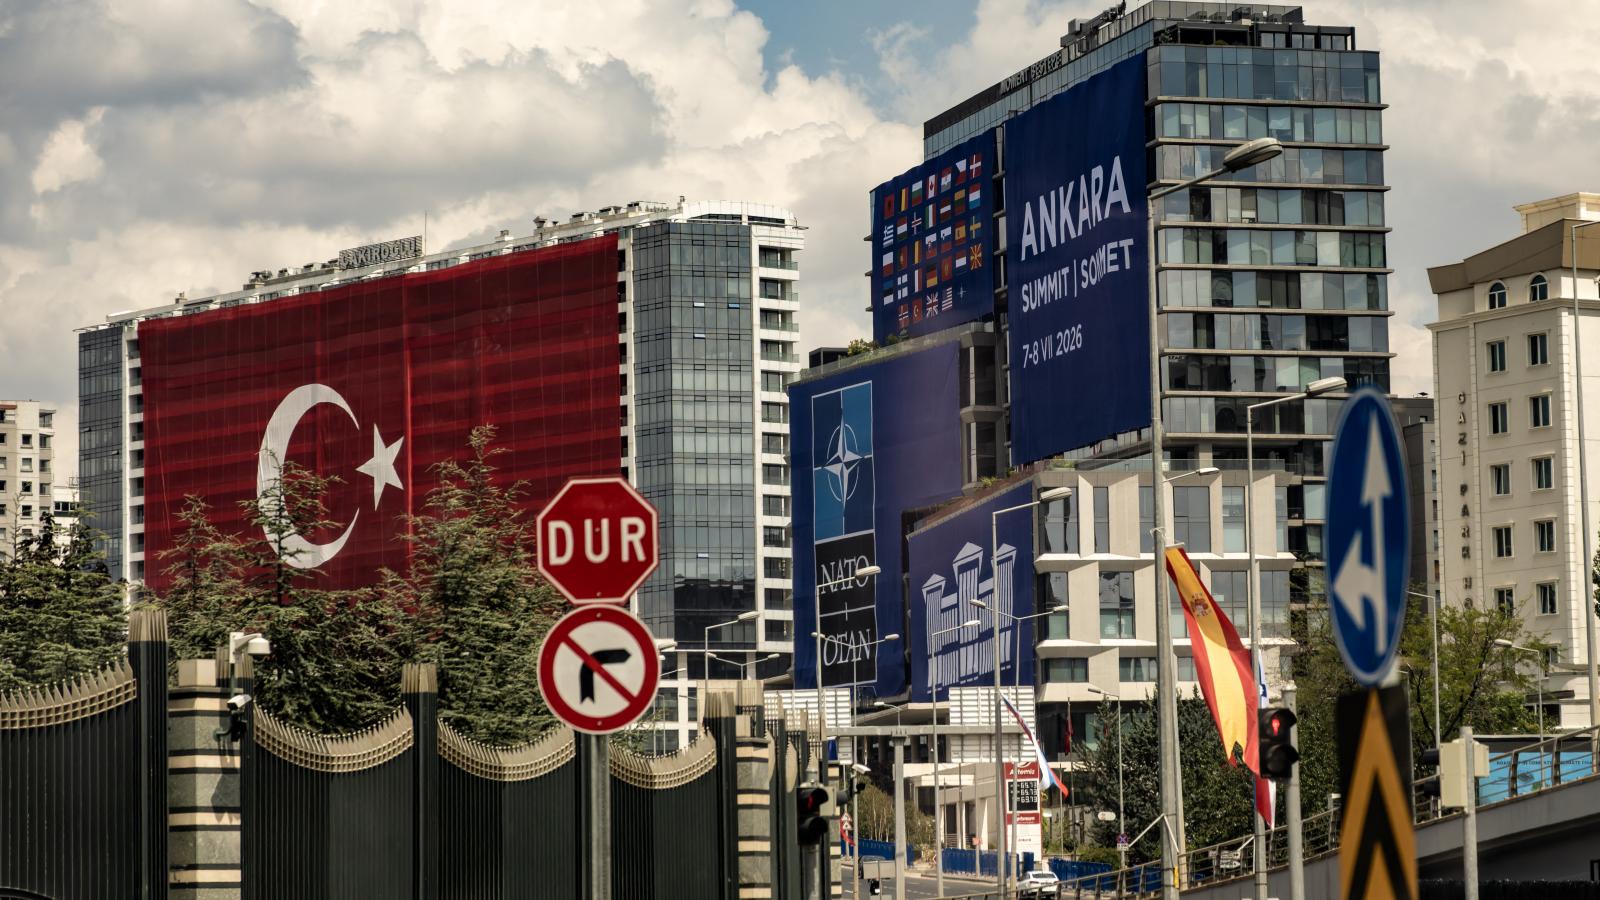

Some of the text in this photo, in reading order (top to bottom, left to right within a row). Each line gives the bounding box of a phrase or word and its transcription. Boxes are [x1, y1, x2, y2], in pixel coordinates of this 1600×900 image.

[1000, 67, 1031, 95] MOMENT
[1021, 155, 1132, 261] ANKARA
[1021, 266, 1070, 313] SUMMIT
[1022, 323, 1083, 369] 7-8 VII 2026
[547, 516, 647, 566] DUR
[820, 555, 870, 594] NATO
[823, 628, 872, 666] OTAN
